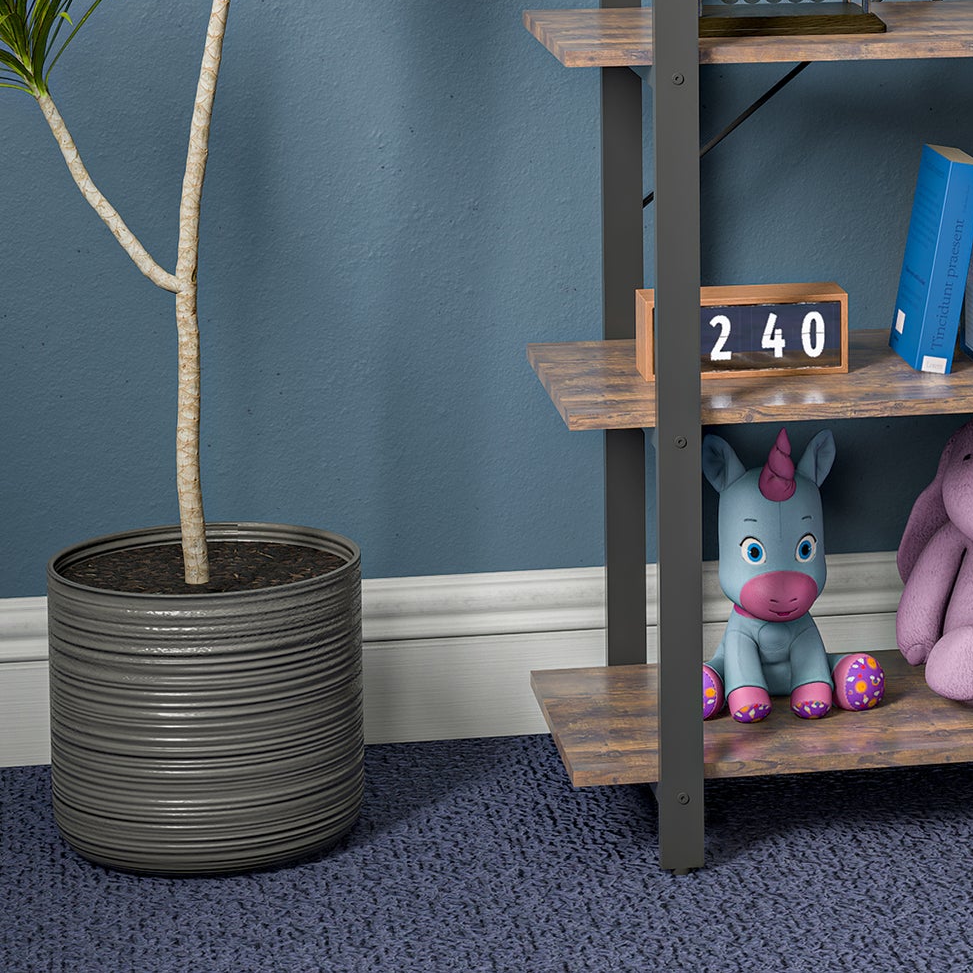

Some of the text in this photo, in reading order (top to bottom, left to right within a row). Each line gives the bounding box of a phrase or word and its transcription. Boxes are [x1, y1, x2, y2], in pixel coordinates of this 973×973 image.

[930, 219, 965, 351] Tincidunt praesent
[709, 314, 732, 361] 2
